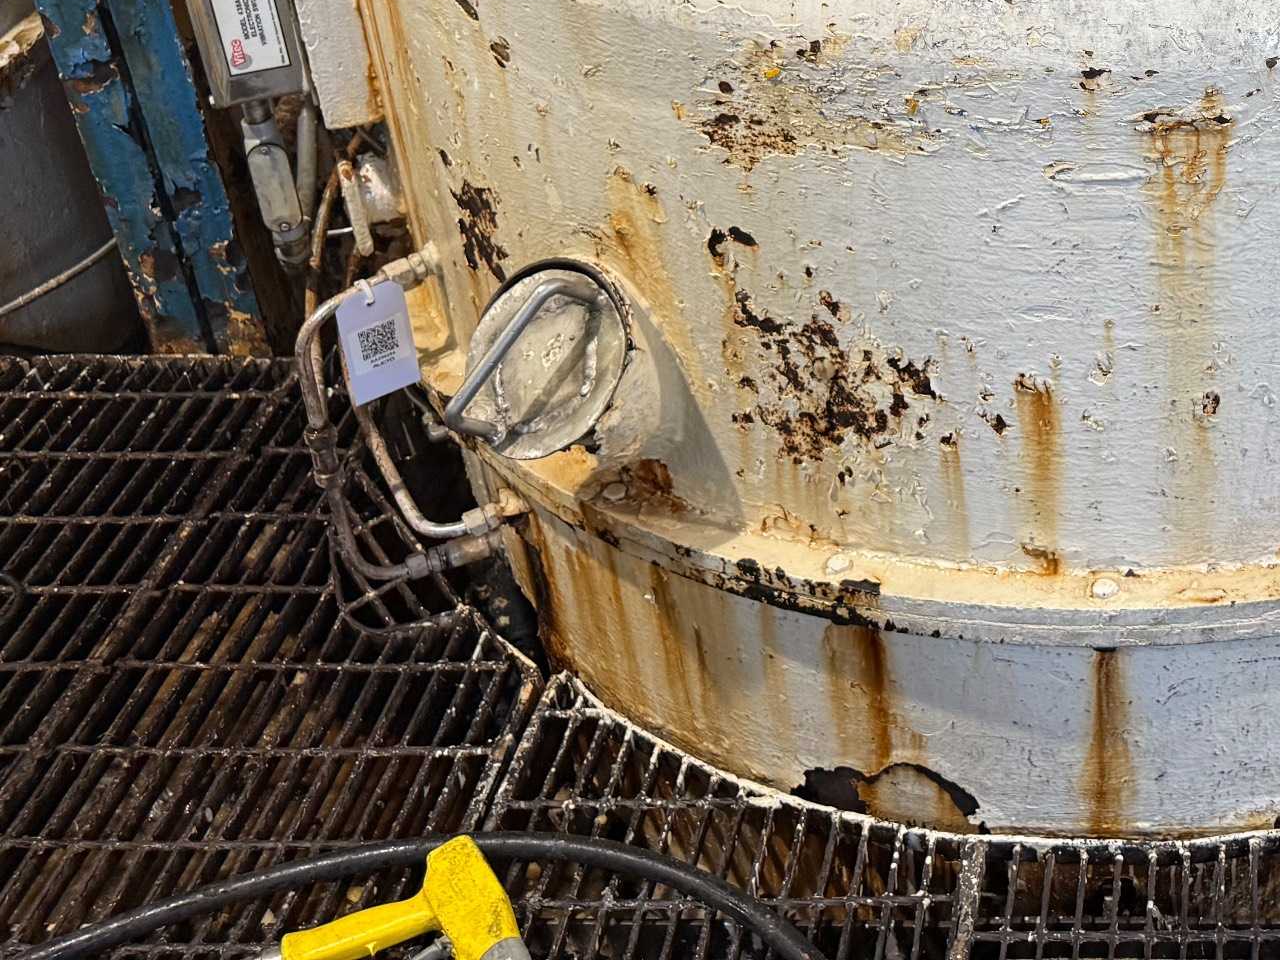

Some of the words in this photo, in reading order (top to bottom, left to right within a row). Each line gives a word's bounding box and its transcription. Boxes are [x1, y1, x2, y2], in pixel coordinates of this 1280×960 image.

[240, 17, 250, 40] MODEL
[242, 0, 257, 38] ELECTRONIC
[255, 14, 267, 47] VIBRATION
